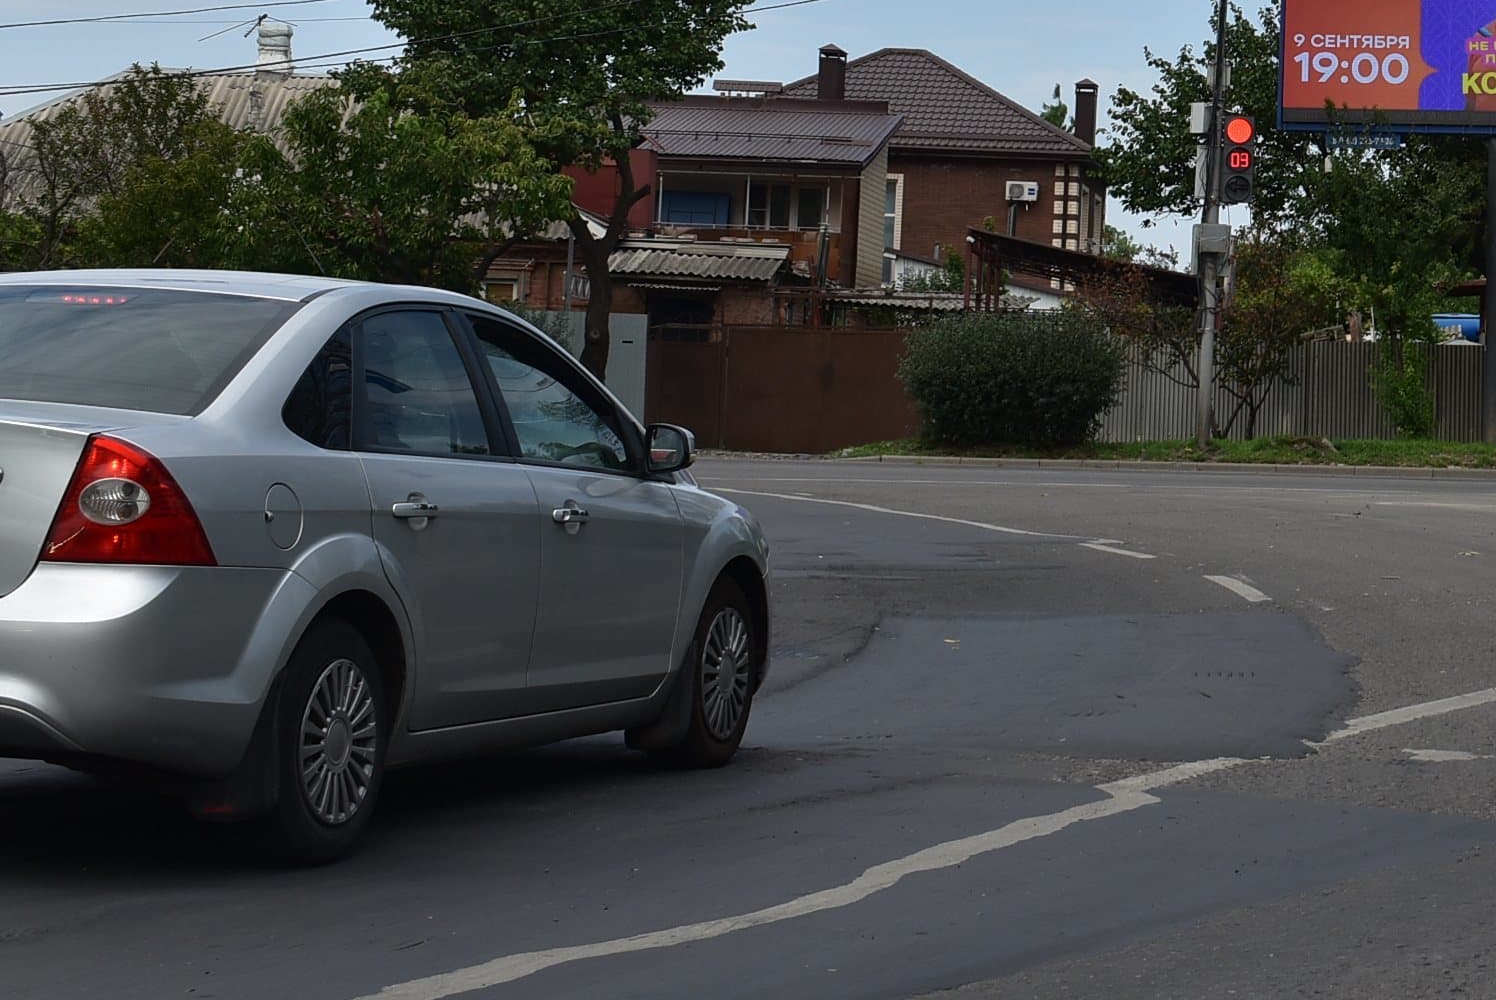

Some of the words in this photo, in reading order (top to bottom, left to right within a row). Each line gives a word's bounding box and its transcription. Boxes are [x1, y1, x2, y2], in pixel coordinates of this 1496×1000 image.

[1294, 33, 1306, 47] 9
[1311, 34, 1410, 49] СЕНТЯБРЯ
[1469, 41, 1489, 51] НЕ
[1294, 51, 1409, 84] 19:00
